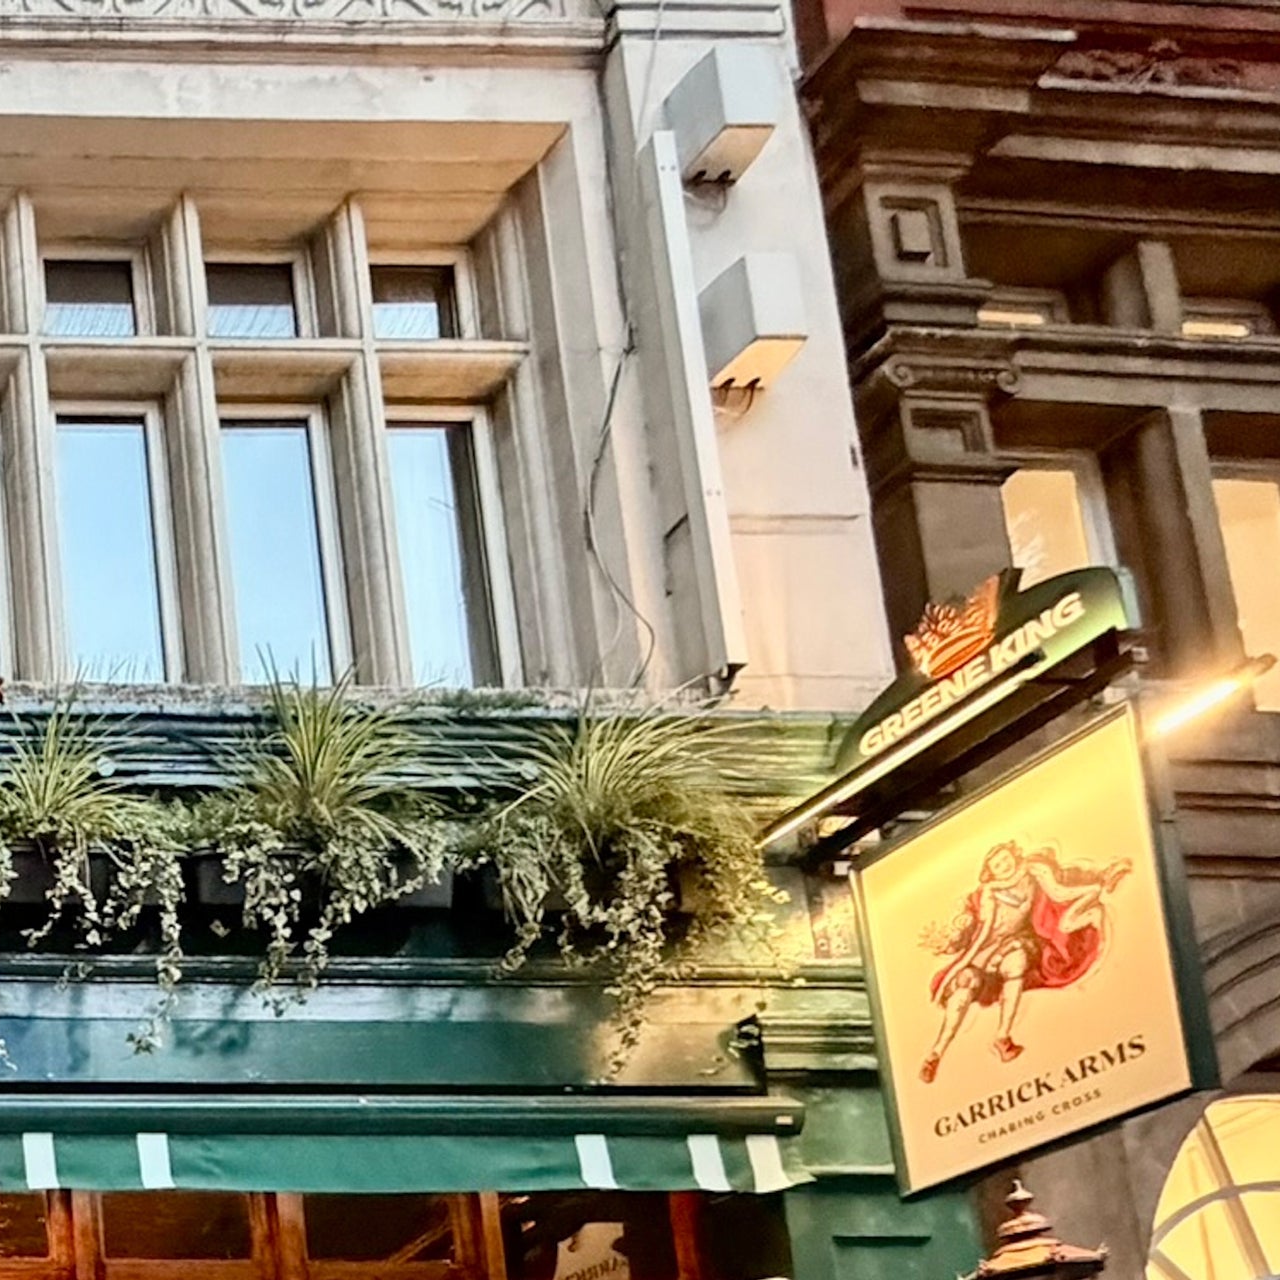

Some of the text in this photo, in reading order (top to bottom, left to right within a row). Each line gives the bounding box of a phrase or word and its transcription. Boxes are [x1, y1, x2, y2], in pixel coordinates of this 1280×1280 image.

[859, 592, 1086, 756] GREENE KING
[934, 1034, 1147, 1138] GARRICK ARMS
[978, 1088, 1102, 1144] CHARING CROSS
